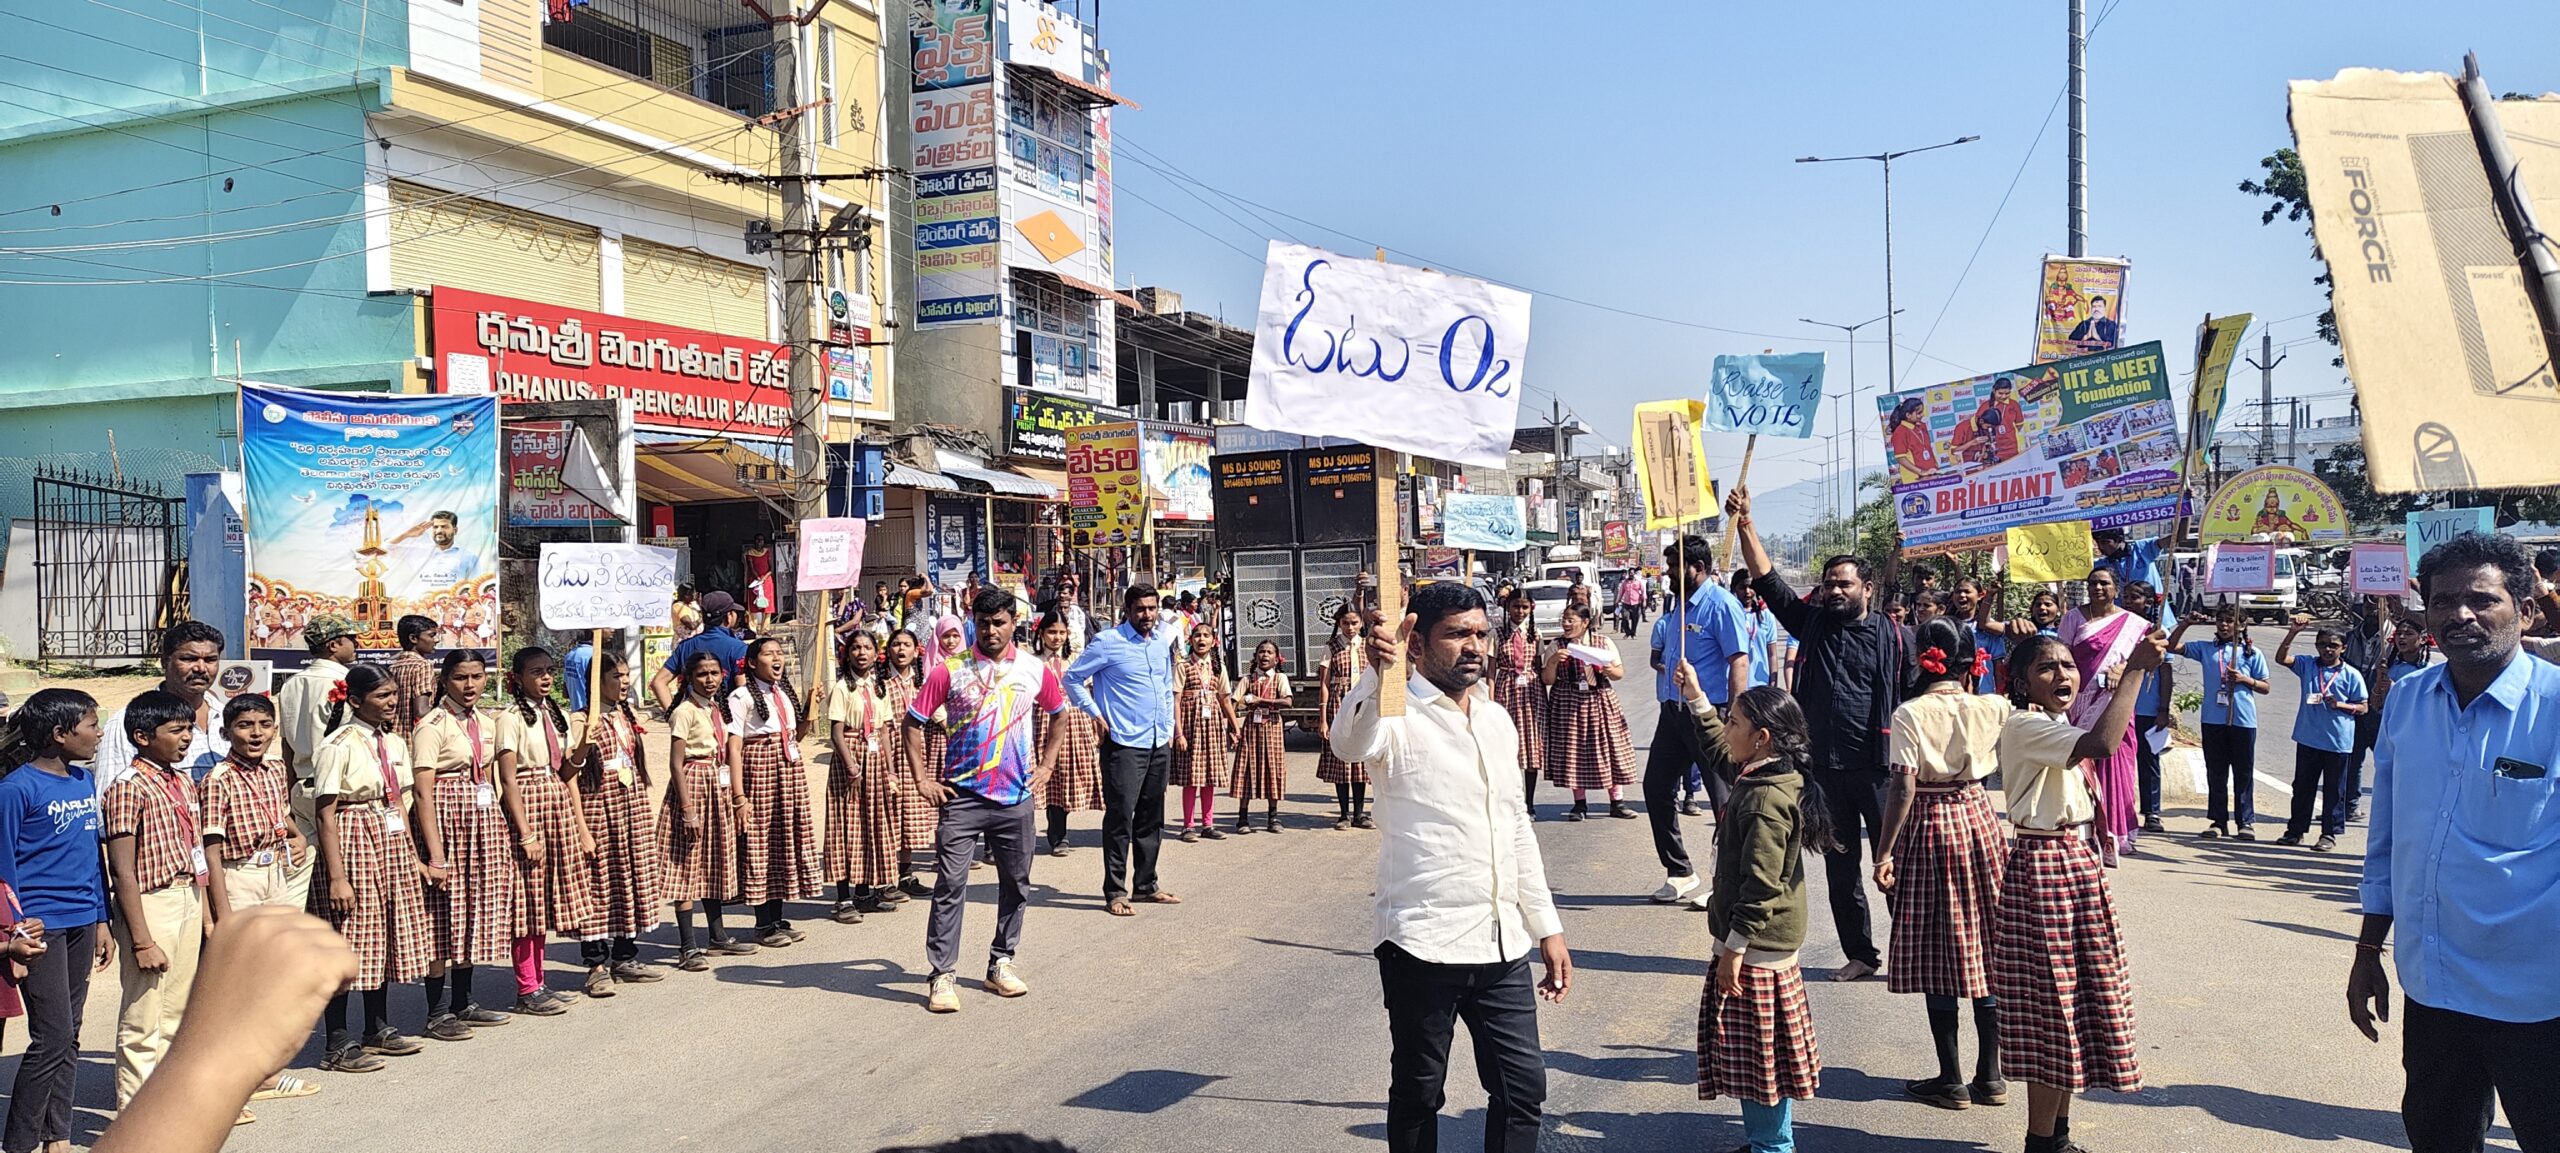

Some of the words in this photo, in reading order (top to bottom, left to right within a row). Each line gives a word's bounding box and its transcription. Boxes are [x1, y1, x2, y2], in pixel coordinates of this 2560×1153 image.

[917, 174, 956, 195] ఫోటో
[1013, 166, 1037, 187] PRESS
[2343, 169, 2393, 284] FORCE
[1283, 259, 1410, 382] ఓటు
[477, 311, 594, 367] ధనుశ్రీ
[600, 329, 744, 382] బెంగుళూర్
[749, 349, 791, 389] బేక
[2069, 356, 2106, 369] Exclusively
[2106, 350, 2135, 364] Focused
[2136, 349, 2146, 357] on
[2063, 369, 2089, 390] IIT
[2094, 368, 2109, 384] &
[2112, 355, 2158, 381] NEET
[1063, 376, 1084, 391] PRESS
[1712, 371, 1789, 400] Raise
[1799, 374, 1819, 401] to
[2074, 379, 2151, 405] Foundation
[631, 386, 730, 423] BENGALUR
[303, 411, 348, 425] పోలీసు
[350, 413, 440, 426] అమరవీరులకు
[1016, 420, 1036, 432] PRINT
[317, 444, 373, 457] నిర్వహణలో
[511, 432, 561, 461] ధనుశ్రీ
[318, 458, 368, 469] అమరులైన
[371, 458, 424, 468] పోలీసులకు
[1068, 444, 1138, 475] బేకరి
[1222, 463, 1235, 475] MS
[1236, 462, 1247, 473] DJ
[1248, 458, 1281, 471] SOUNDS
[1308, 457, 1322, 469] MS
[1323, 455, 1335, 467] DJ
[1337, 452, 1371, 466] SOUNDS
[373, 470, 400, 481] ప్రజల
[326, 480, 377, 492] వినమ్రతతో
[1936, 472, 2057, 514] BRILLIANT
[1928, 523, 1958, 534] Foundation
[1962, 518, 1983, 528] Nursery
[1991, 515, 2004, 524] Class
[2028, 509, 2039, 518] Day
[2045, 502, 2075, 514] Residential
[1965, 505, 1999, 518] GRAMMAR
[2001, 503, 2017, 513] HIGH
[2018, 498, 2044, 510] SCHOOL
[2100, 505, 2175, 528] 9182453362
[1912, 536, 1927, 545] Main
[1928, 533, 1945, 543] Road,
[1947, 529, 1971, 541] Mulugu
[2412, 518, 2462, 542] VOTE
[1909, 546, 1921, 555] For
[1989, 535, 2003, 544] Call
[2016, 534, 2050, 556] ఓటు
[2216, 555, 2235, 564] Don't
[2246, 555, 2265, 563] Silent
[544, 552, 590, 588] ఓటు
[2225, 566, 2235, 574] Be
[2360, 566, 2373, 574] ఓటు
[225, 667, 249, 679] Dairy
[227, 677, 245, 688] Day
